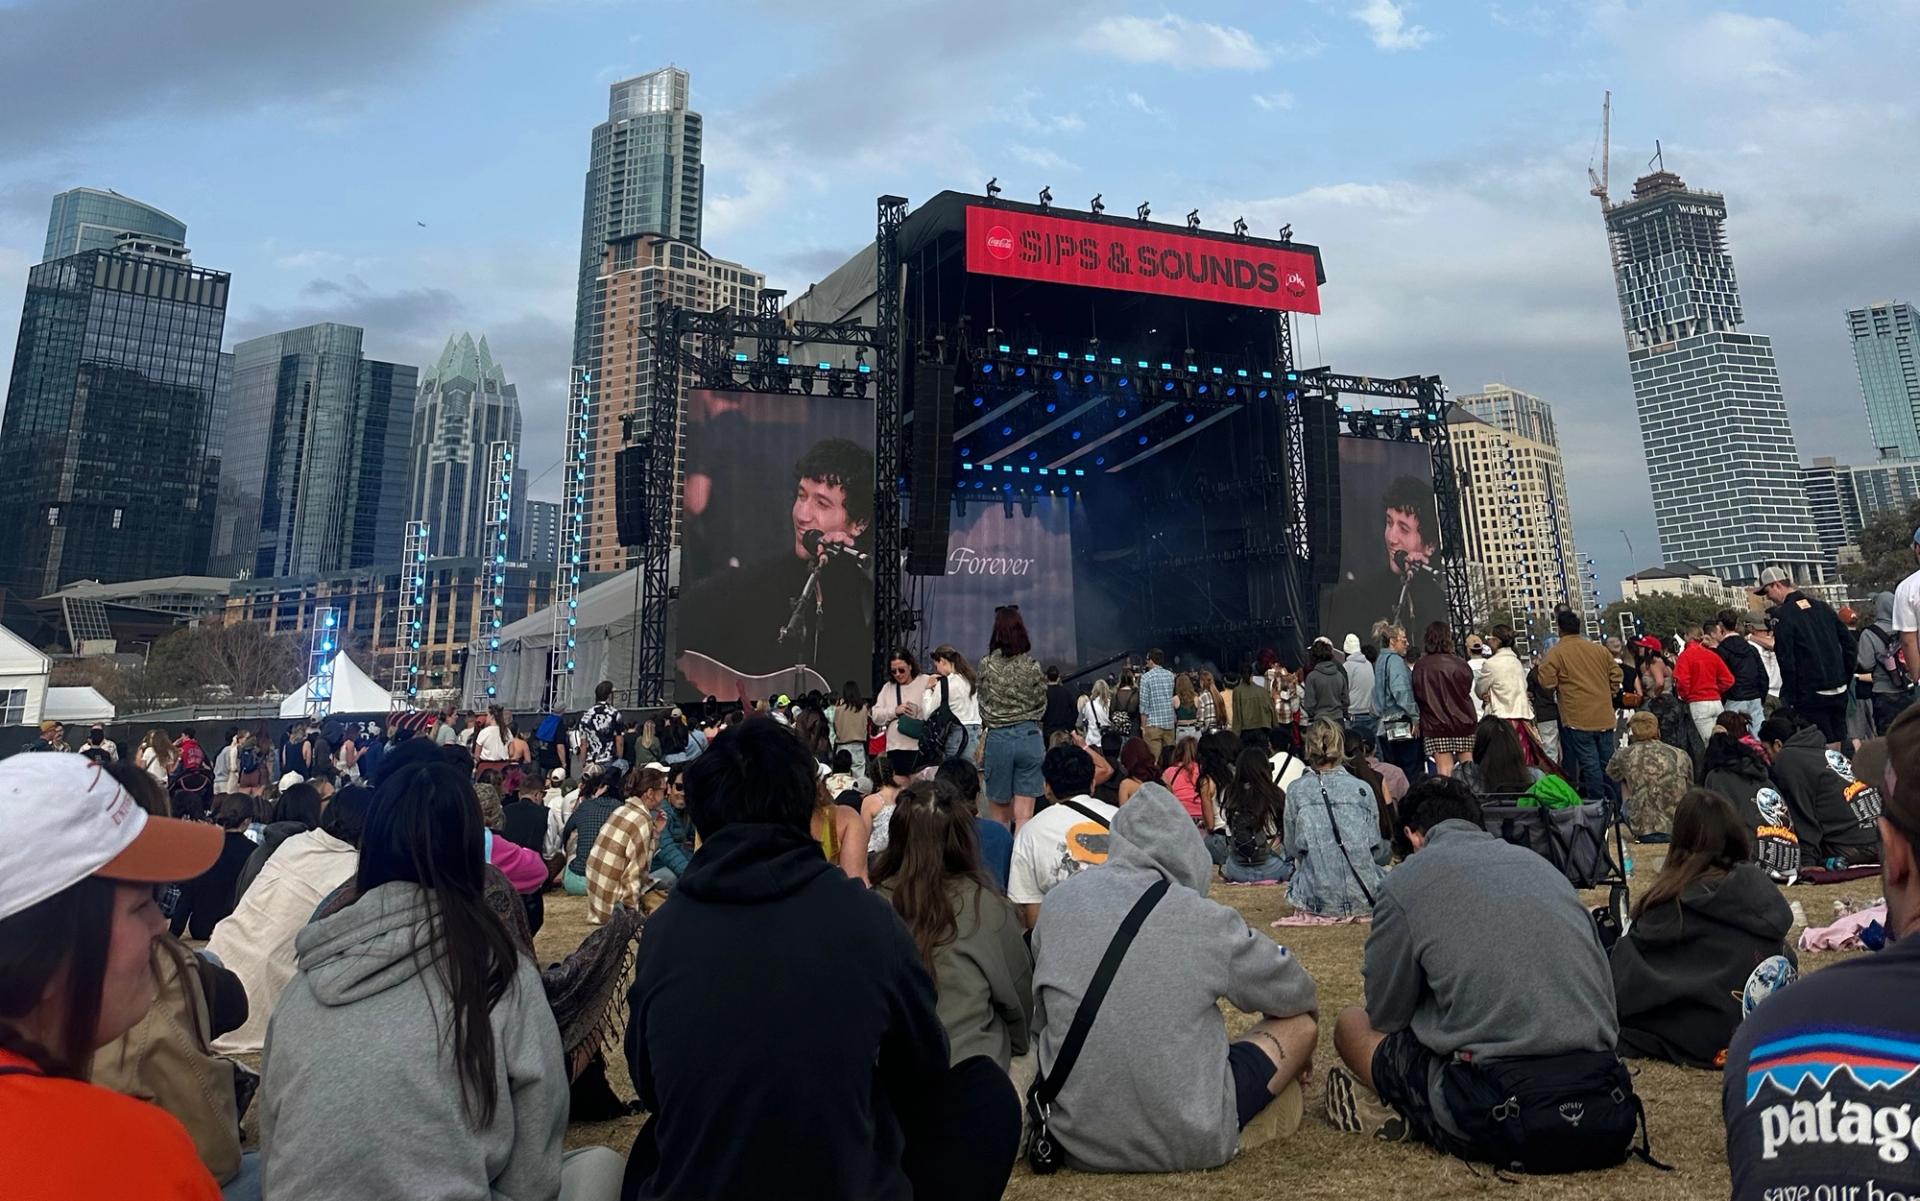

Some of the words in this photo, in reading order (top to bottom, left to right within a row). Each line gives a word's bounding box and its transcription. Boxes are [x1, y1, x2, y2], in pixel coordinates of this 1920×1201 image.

[1019, 230, 1101, 270] SIPS
[1108, 242, 1133, 275] &
[1138, 245, 1279, 293] SOUNDS
[947, 547, 1034, 575] Forever
[1760, 1091, 1920, 1164] patag
[1763, 1185, 1810, 1201] save
[1814, 1184, 1860, 1201] our
